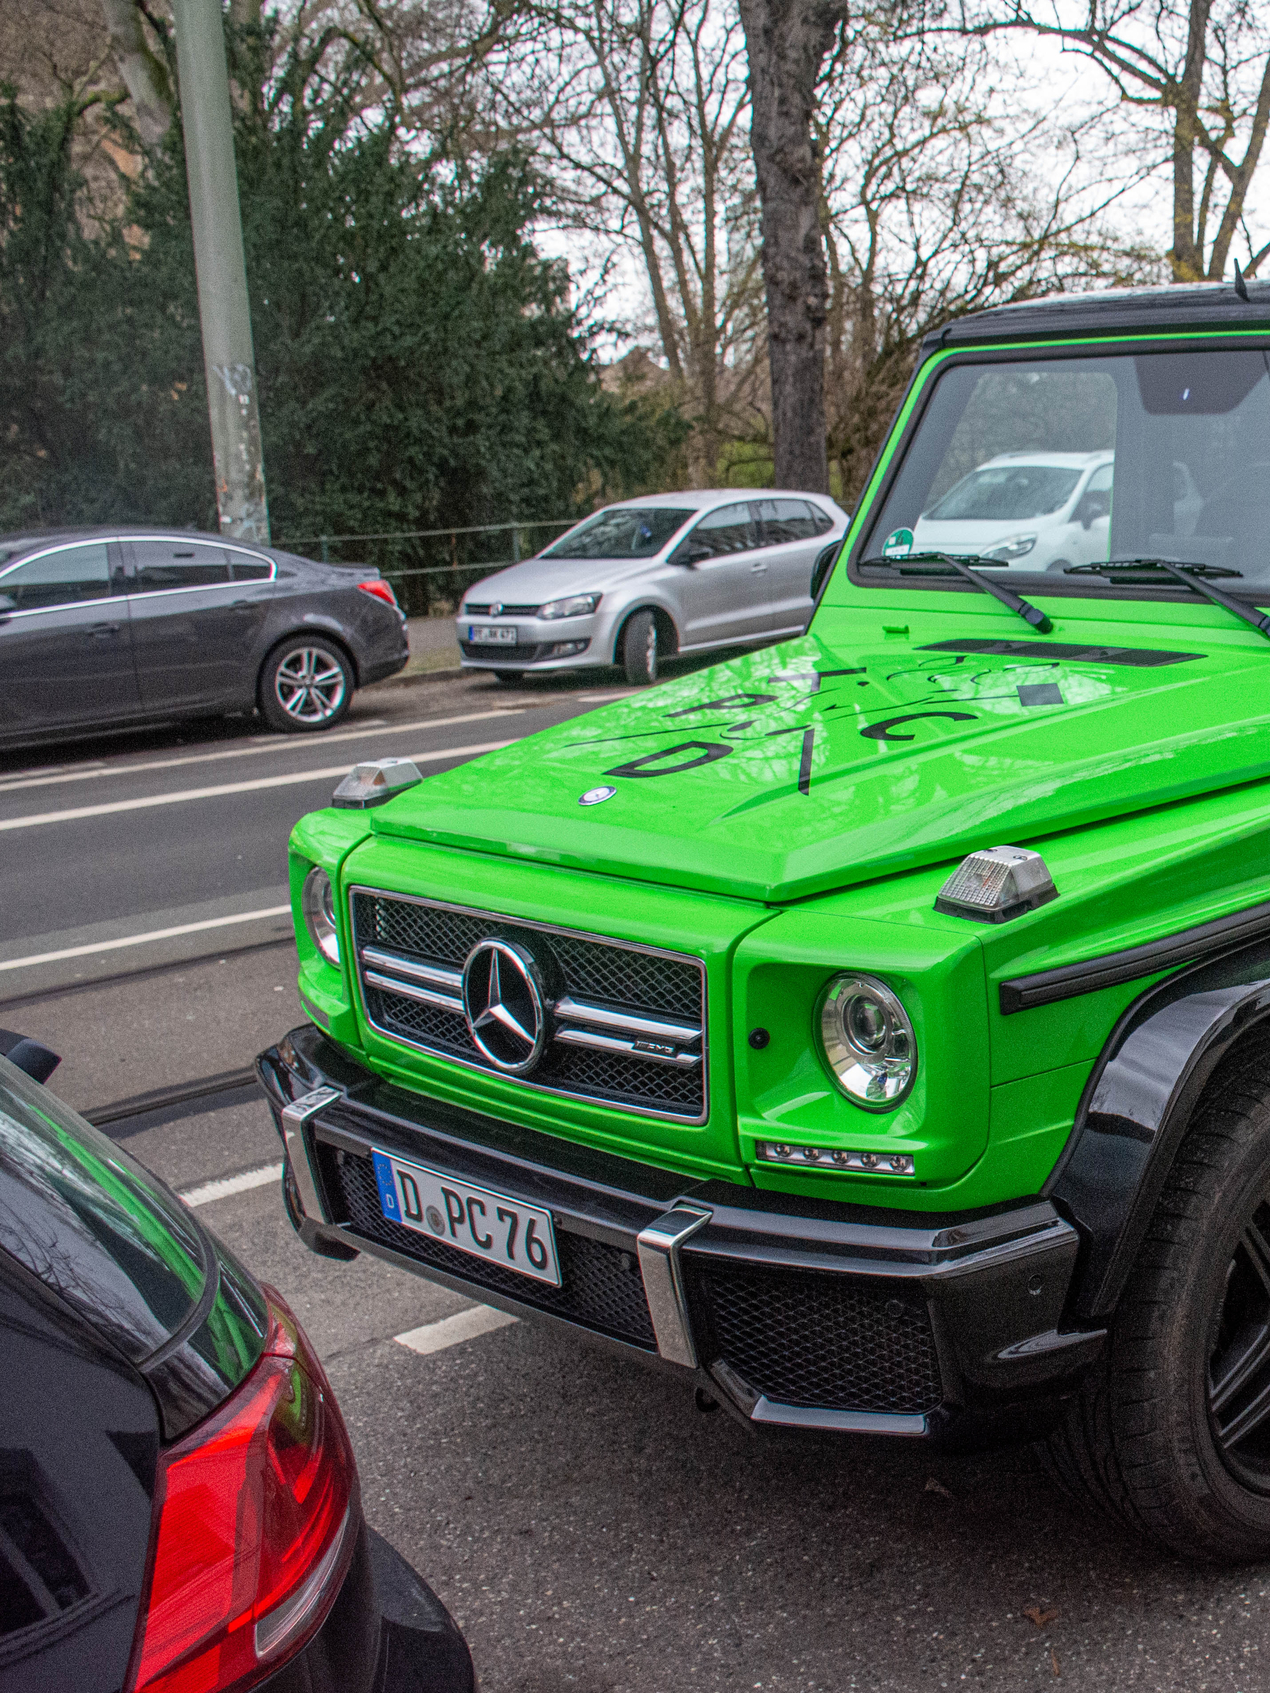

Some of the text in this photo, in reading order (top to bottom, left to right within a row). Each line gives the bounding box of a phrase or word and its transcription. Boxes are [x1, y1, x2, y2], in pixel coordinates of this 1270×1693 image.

[663, 692, 979, 742] P C
[601, 740, 735, 780] D
